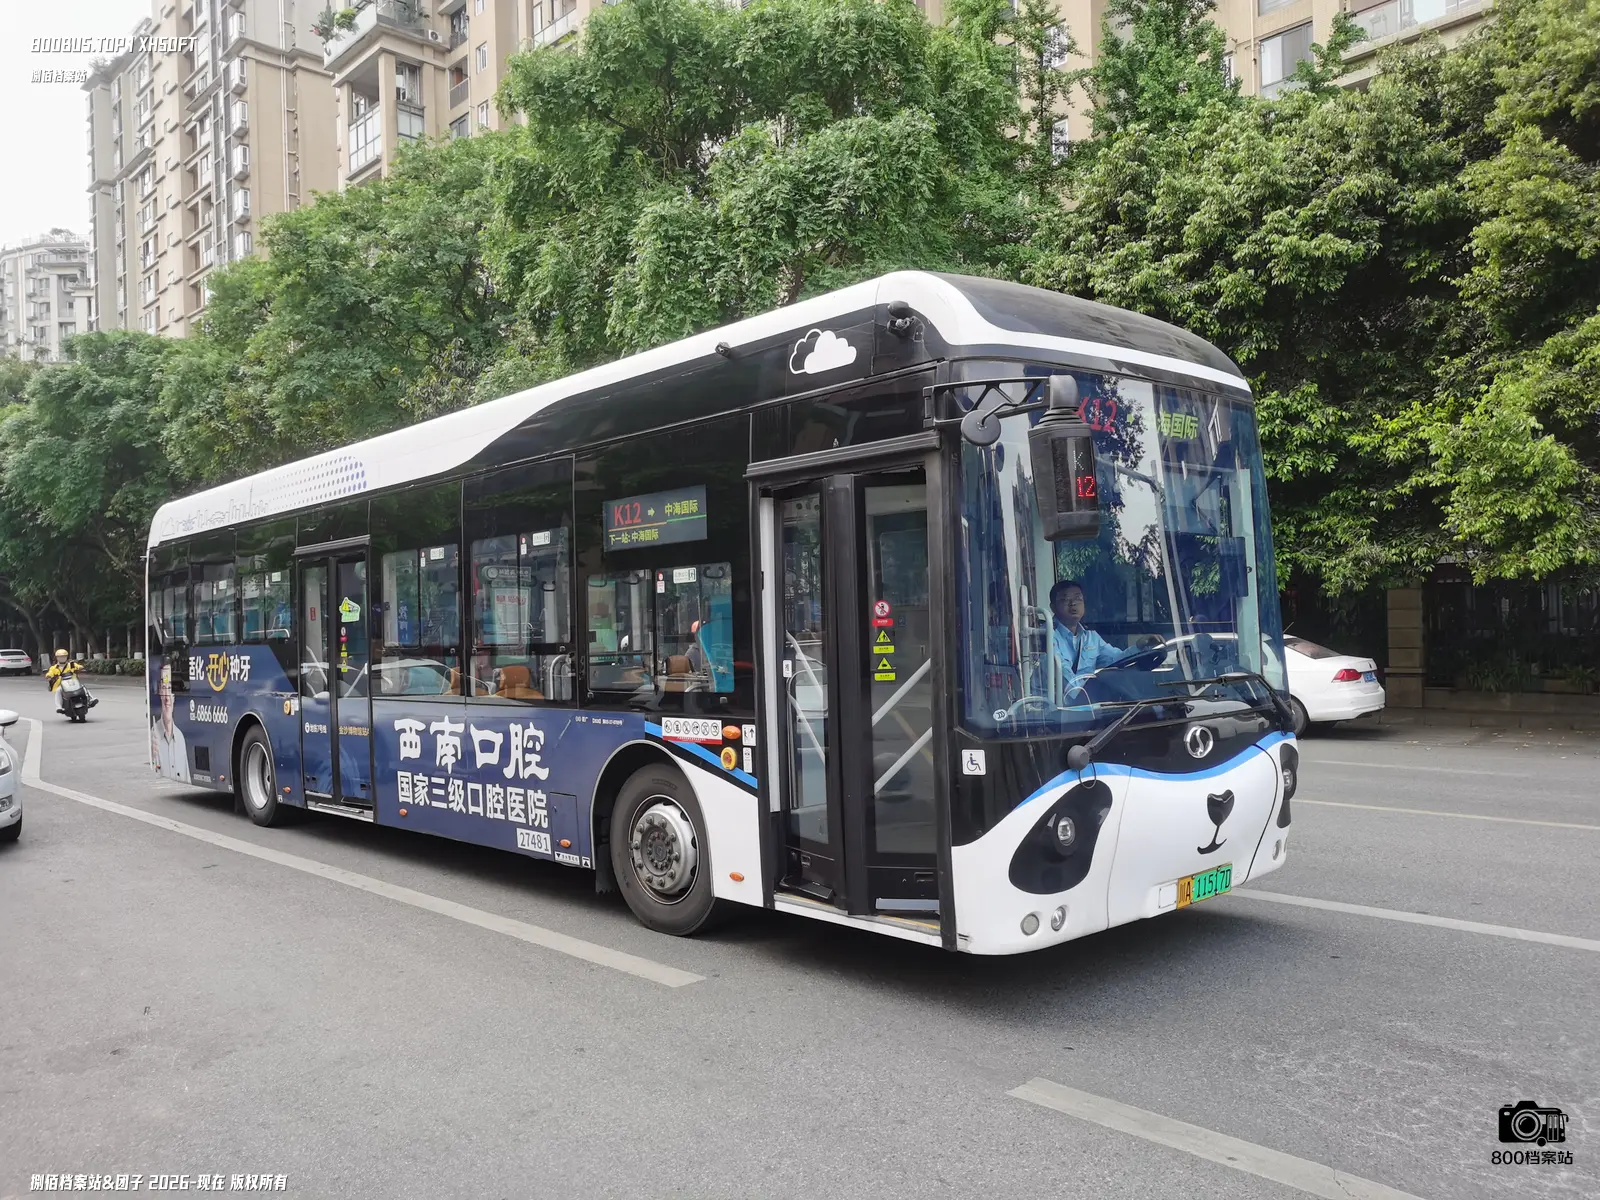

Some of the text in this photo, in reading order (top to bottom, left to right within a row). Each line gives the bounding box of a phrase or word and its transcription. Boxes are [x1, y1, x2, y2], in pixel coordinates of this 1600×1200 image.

[1157, 412, 1198, 440] 海国际
[1077, 476, 1095, 497] 12
[614, 499, 699, 527] K12 中海国际
[394, 715, 549, 781] 西南口腔
[397, 771, 549, 829] 国家三级口腔医院
[519, 831, 550, 852] 27481
